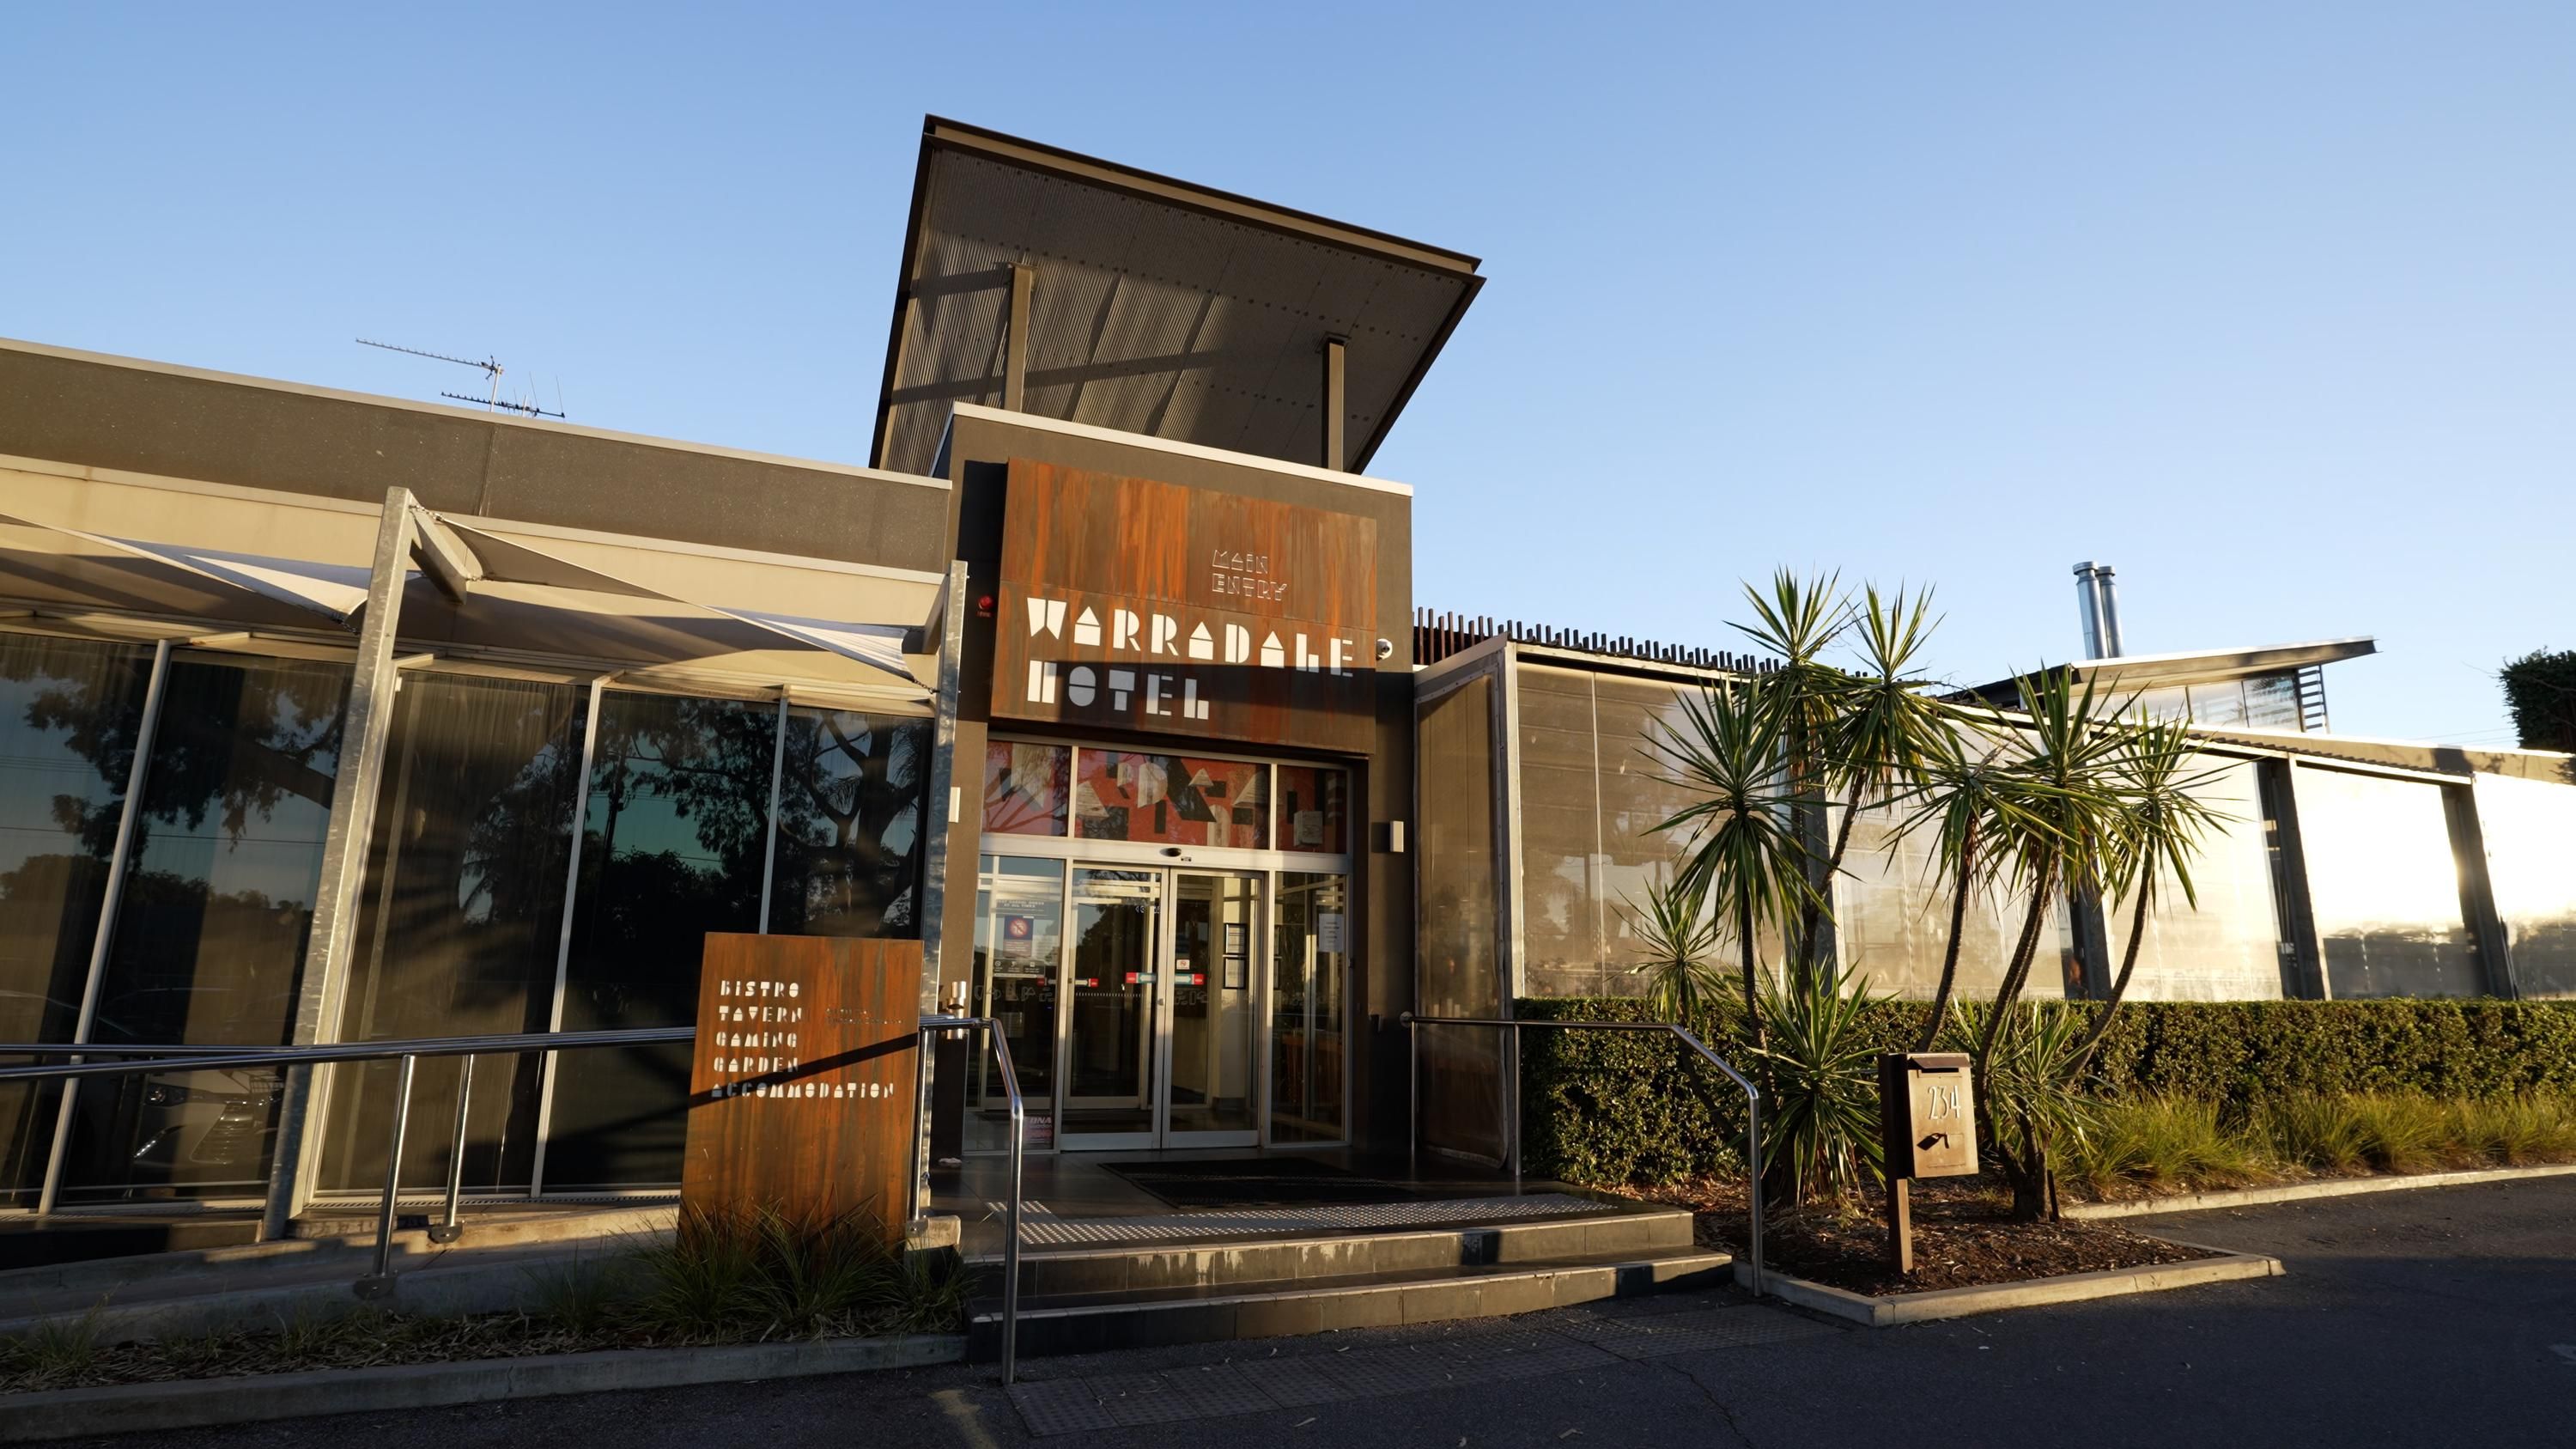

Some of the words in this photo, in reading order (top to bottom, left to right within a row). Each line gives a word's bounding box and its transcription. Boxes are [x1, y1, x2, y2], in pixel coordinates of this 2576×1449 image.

[1212, 550, 1268, 574] MAIN
[1212, 573, 1288, 601] ENTRY
[1027, 597, 1353, 677] WARRADALE
[1027, 660, 1209, 721] HOTEL
[720, 980, 799, 998] BISTRO
[719, 1005, 802, 1023] TAVERN
[716, 1032, 798, 1048] GAMING
[714, 1056, 799, 1073] GARDEN
[711, 1082, 894, 1099] ACCOMMODATION
[1928, 1085, 1961, 1121] 234
